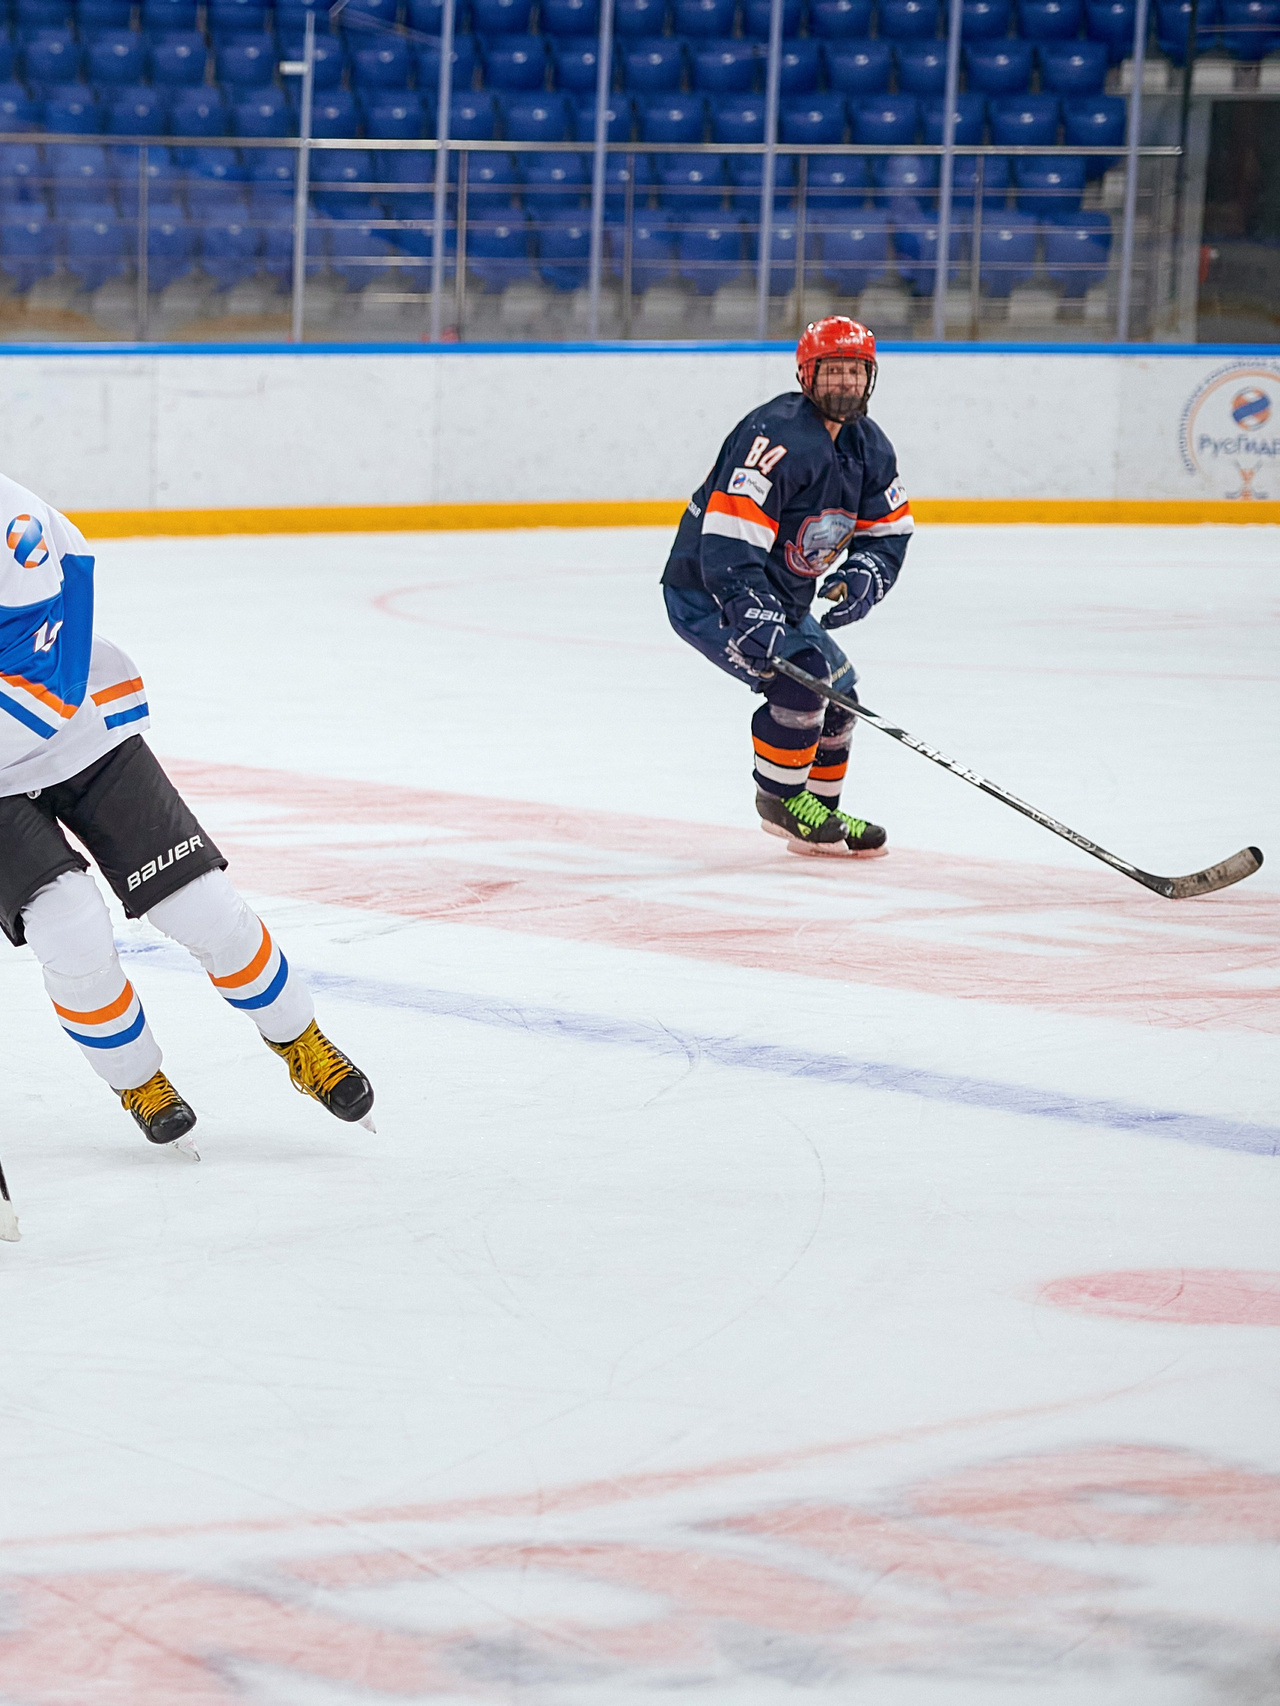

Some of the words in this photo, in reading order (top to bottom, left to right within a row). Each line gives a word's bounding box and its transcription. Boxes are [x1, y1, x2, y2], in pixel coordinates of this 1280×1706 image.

[744, 436, 788, 476] 84
[744, 607, 786, 624] BAU
[127, 834, 204, 892] BAUER
